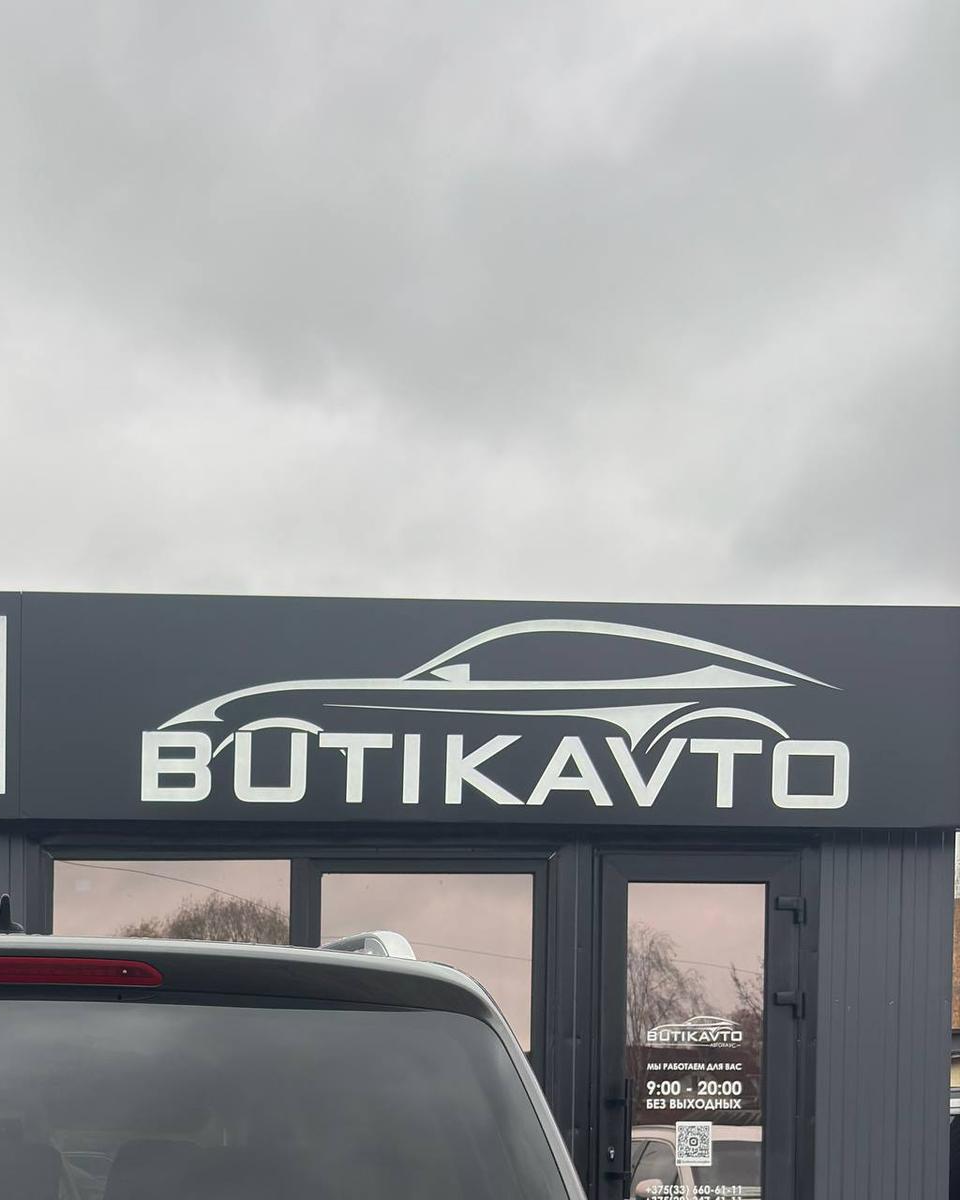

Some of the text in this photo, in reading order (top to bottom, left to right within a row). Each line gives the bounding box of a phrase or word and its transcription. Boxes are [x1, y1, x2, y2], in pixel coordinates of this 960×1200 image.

[141, 730, 850, 809] BUTIKAVTO
[647, 1030, 742, 1042] BUTIKAVTO
[647, 1063, 742, 1071] МЫ РАБОТАЕМ ДЛЯ ВАС
[647, 1081, 681, 1096] 9:00
[697, 1081, 742, 1096] 20:00
[646, 1099, 742, 1111] БЕЗ ВЫХОДНЫХ
[645, 1184, 742, 1197] +375(33) 660-61-11
